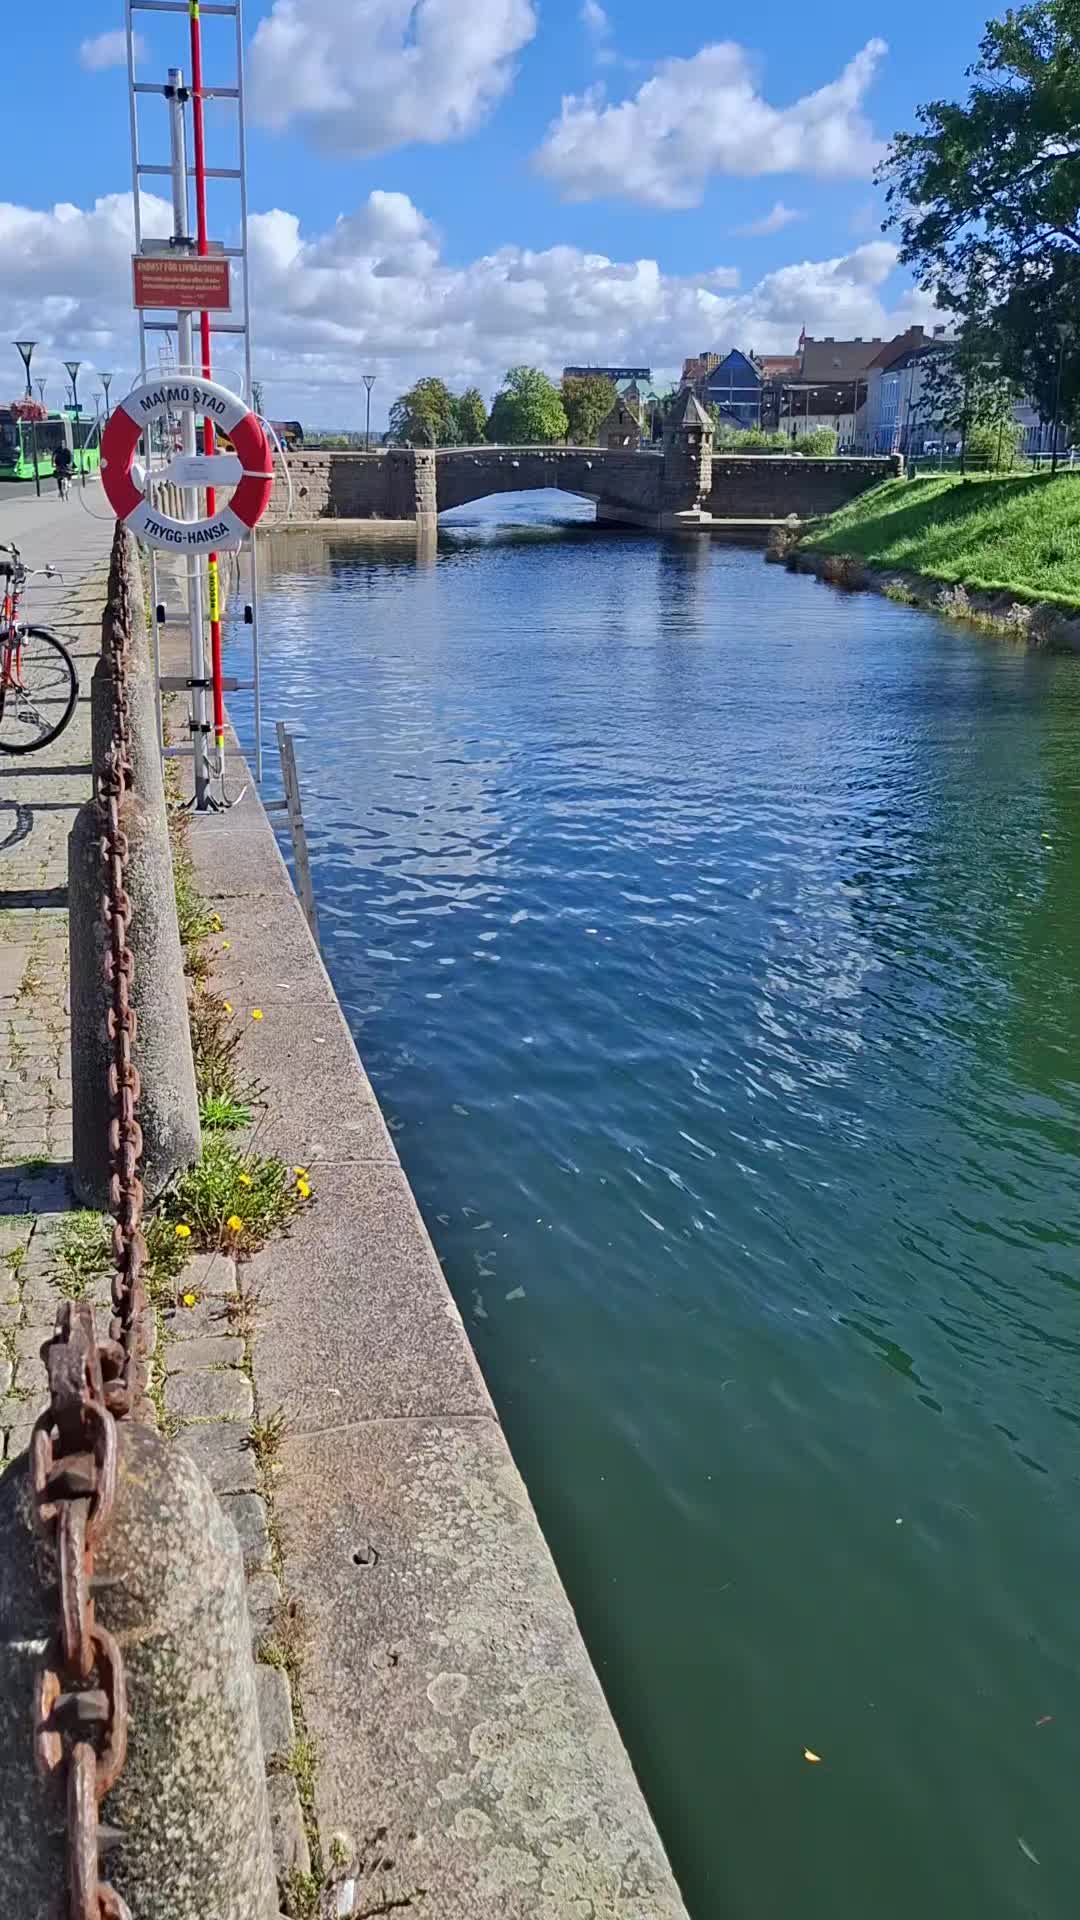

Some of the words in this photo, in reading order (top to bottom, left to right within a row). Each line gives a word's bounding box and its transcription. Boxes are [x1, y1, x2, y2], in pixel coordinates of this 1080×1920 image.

[140, 385, 189, 411] MALMÖ
[193, 387, 226, 414] STAD
[143, 518, 230, 544] TRYGG-HANSA
